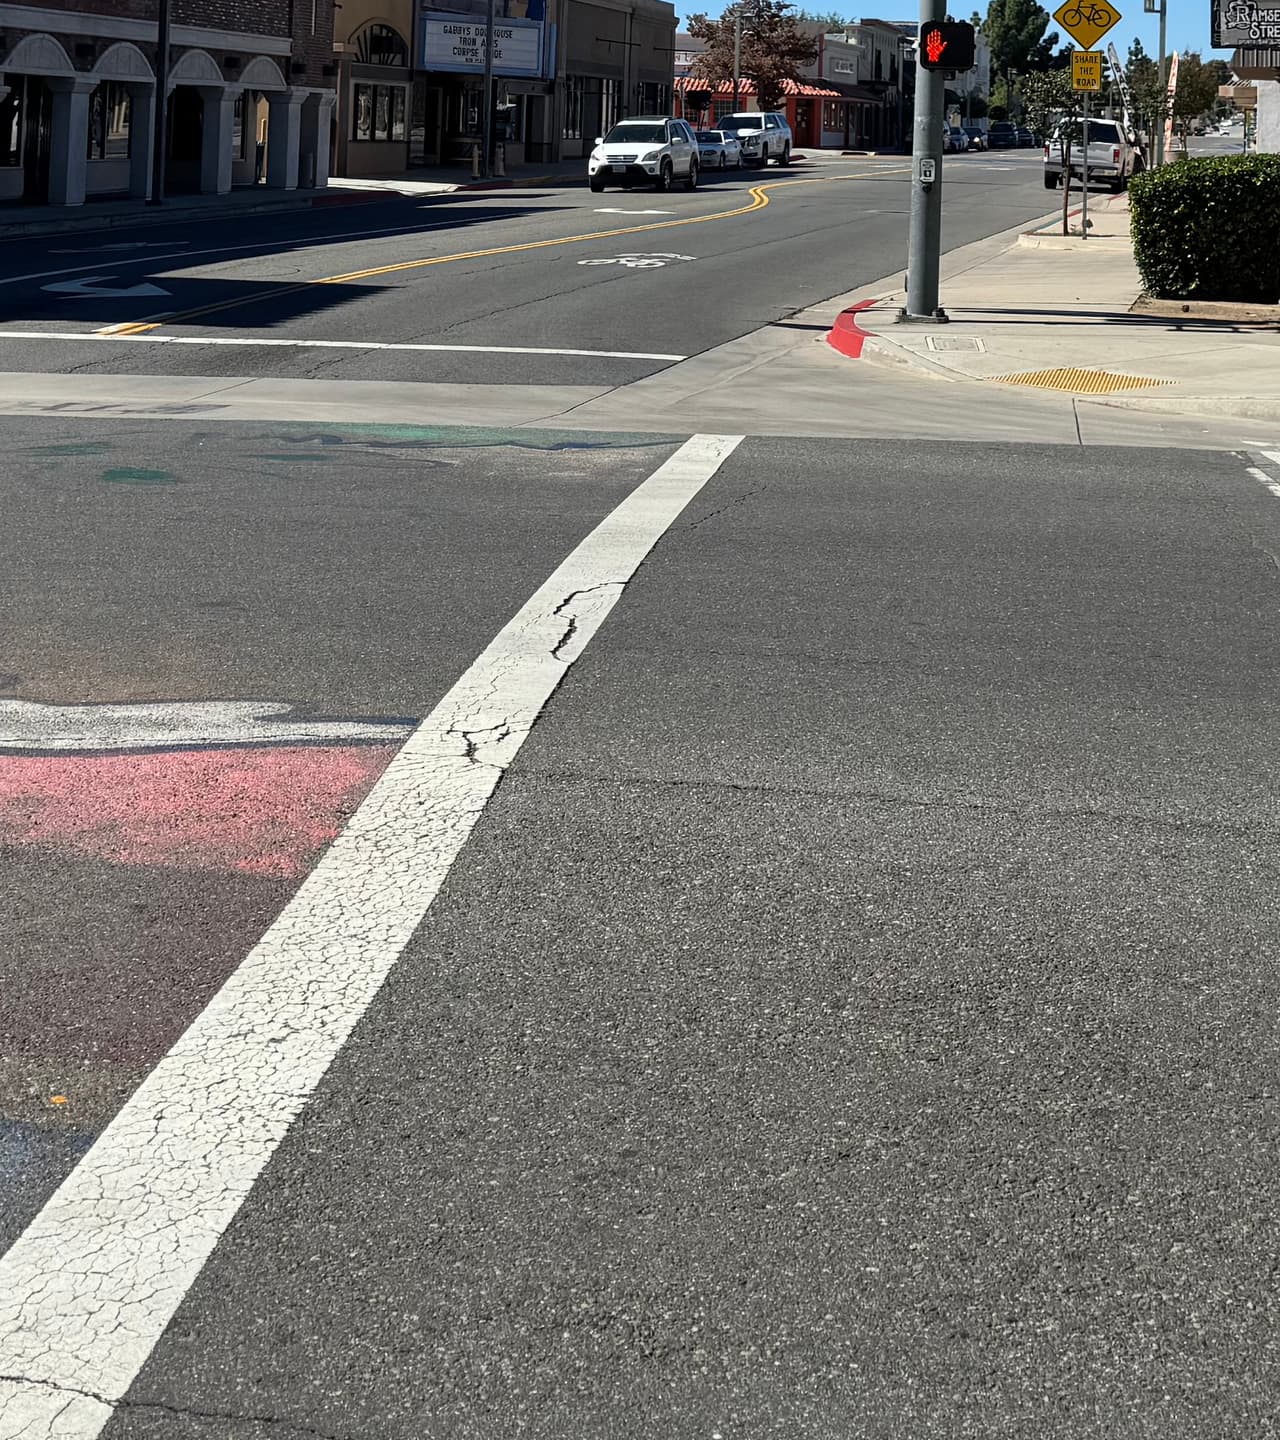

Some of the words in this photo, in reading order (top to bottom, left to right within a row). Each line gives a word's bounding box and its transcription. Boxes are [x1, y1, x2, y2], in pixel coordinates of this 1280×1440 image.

[1075, 55, 1099, 64] SHARE
[1080, 66, 1095, 76] THE
[1076, 78, 1097, 87] ROAD
